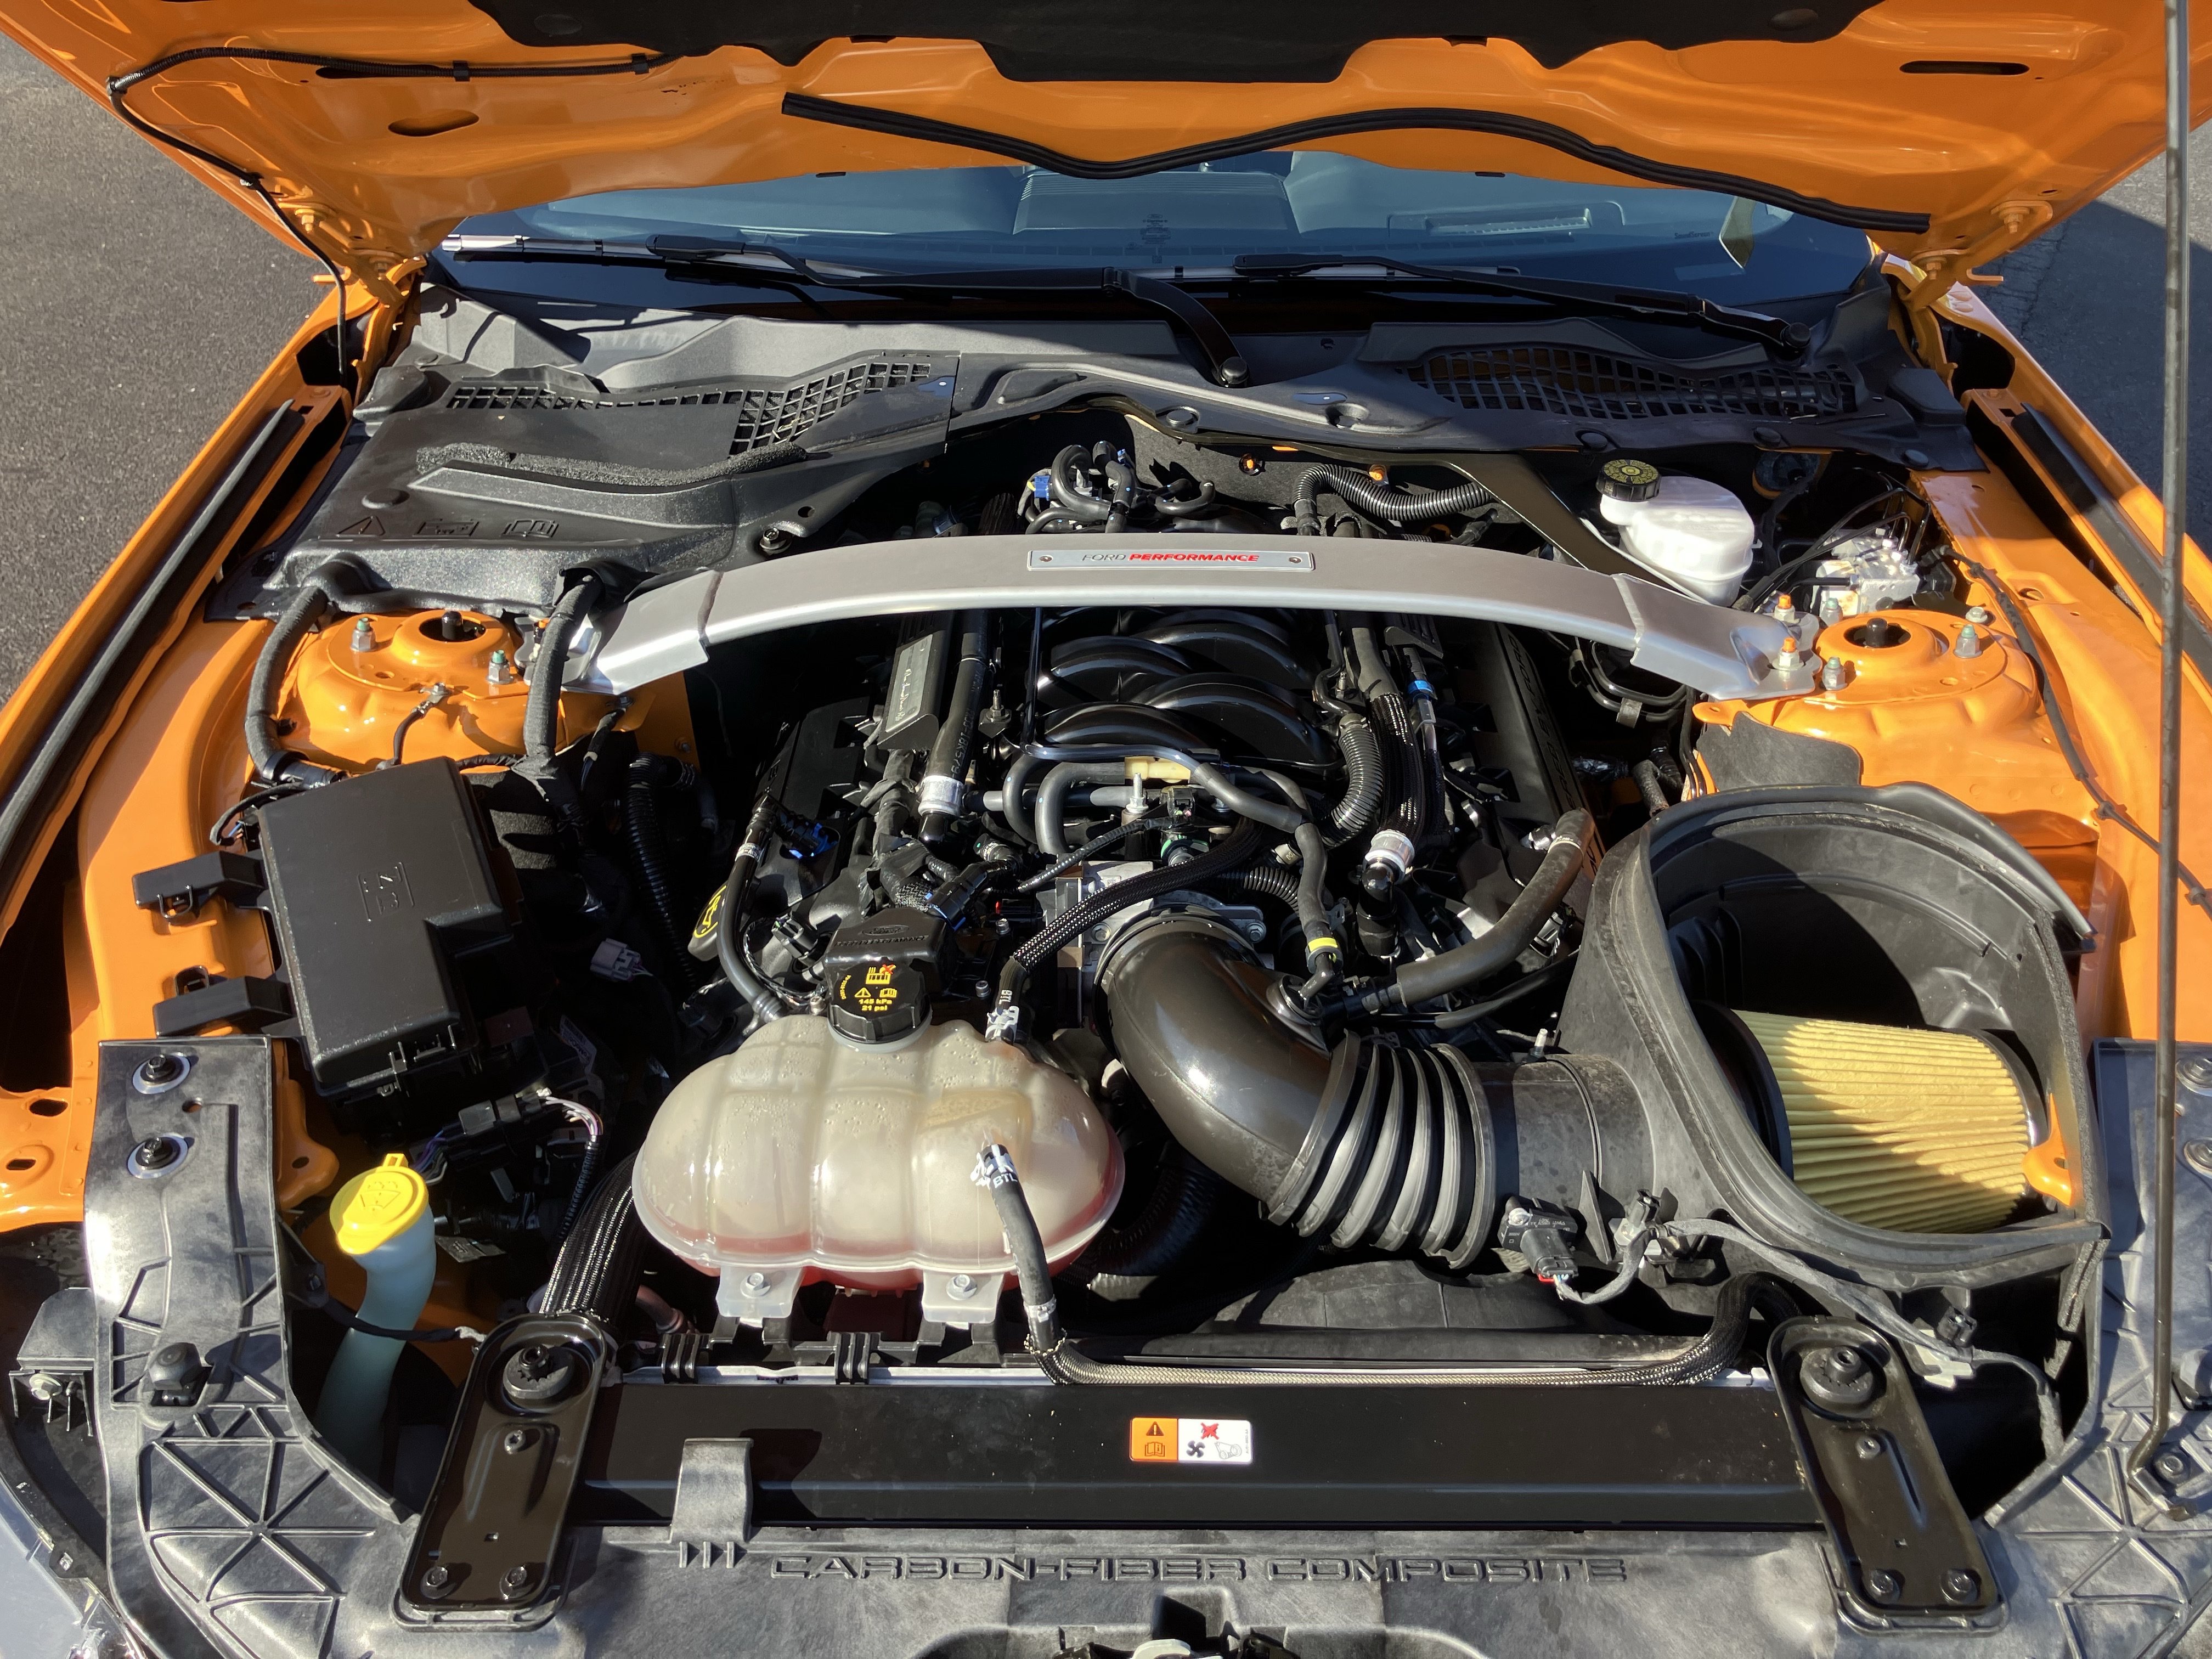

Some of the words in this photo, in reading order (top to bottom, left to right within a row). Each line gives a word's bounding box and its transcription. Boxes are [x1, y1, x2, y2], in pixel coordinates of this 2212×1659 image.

[1128, 554, 1260, 562] PERFORMANCE
[1509, 635, 1534, 695] FORD
[993, 1173, 1018, 1188] BTL
[770, 1556, 1246, 1582] CARBON-FIBER
[1267, 1558, 1628, 1583] COMPOSITE
